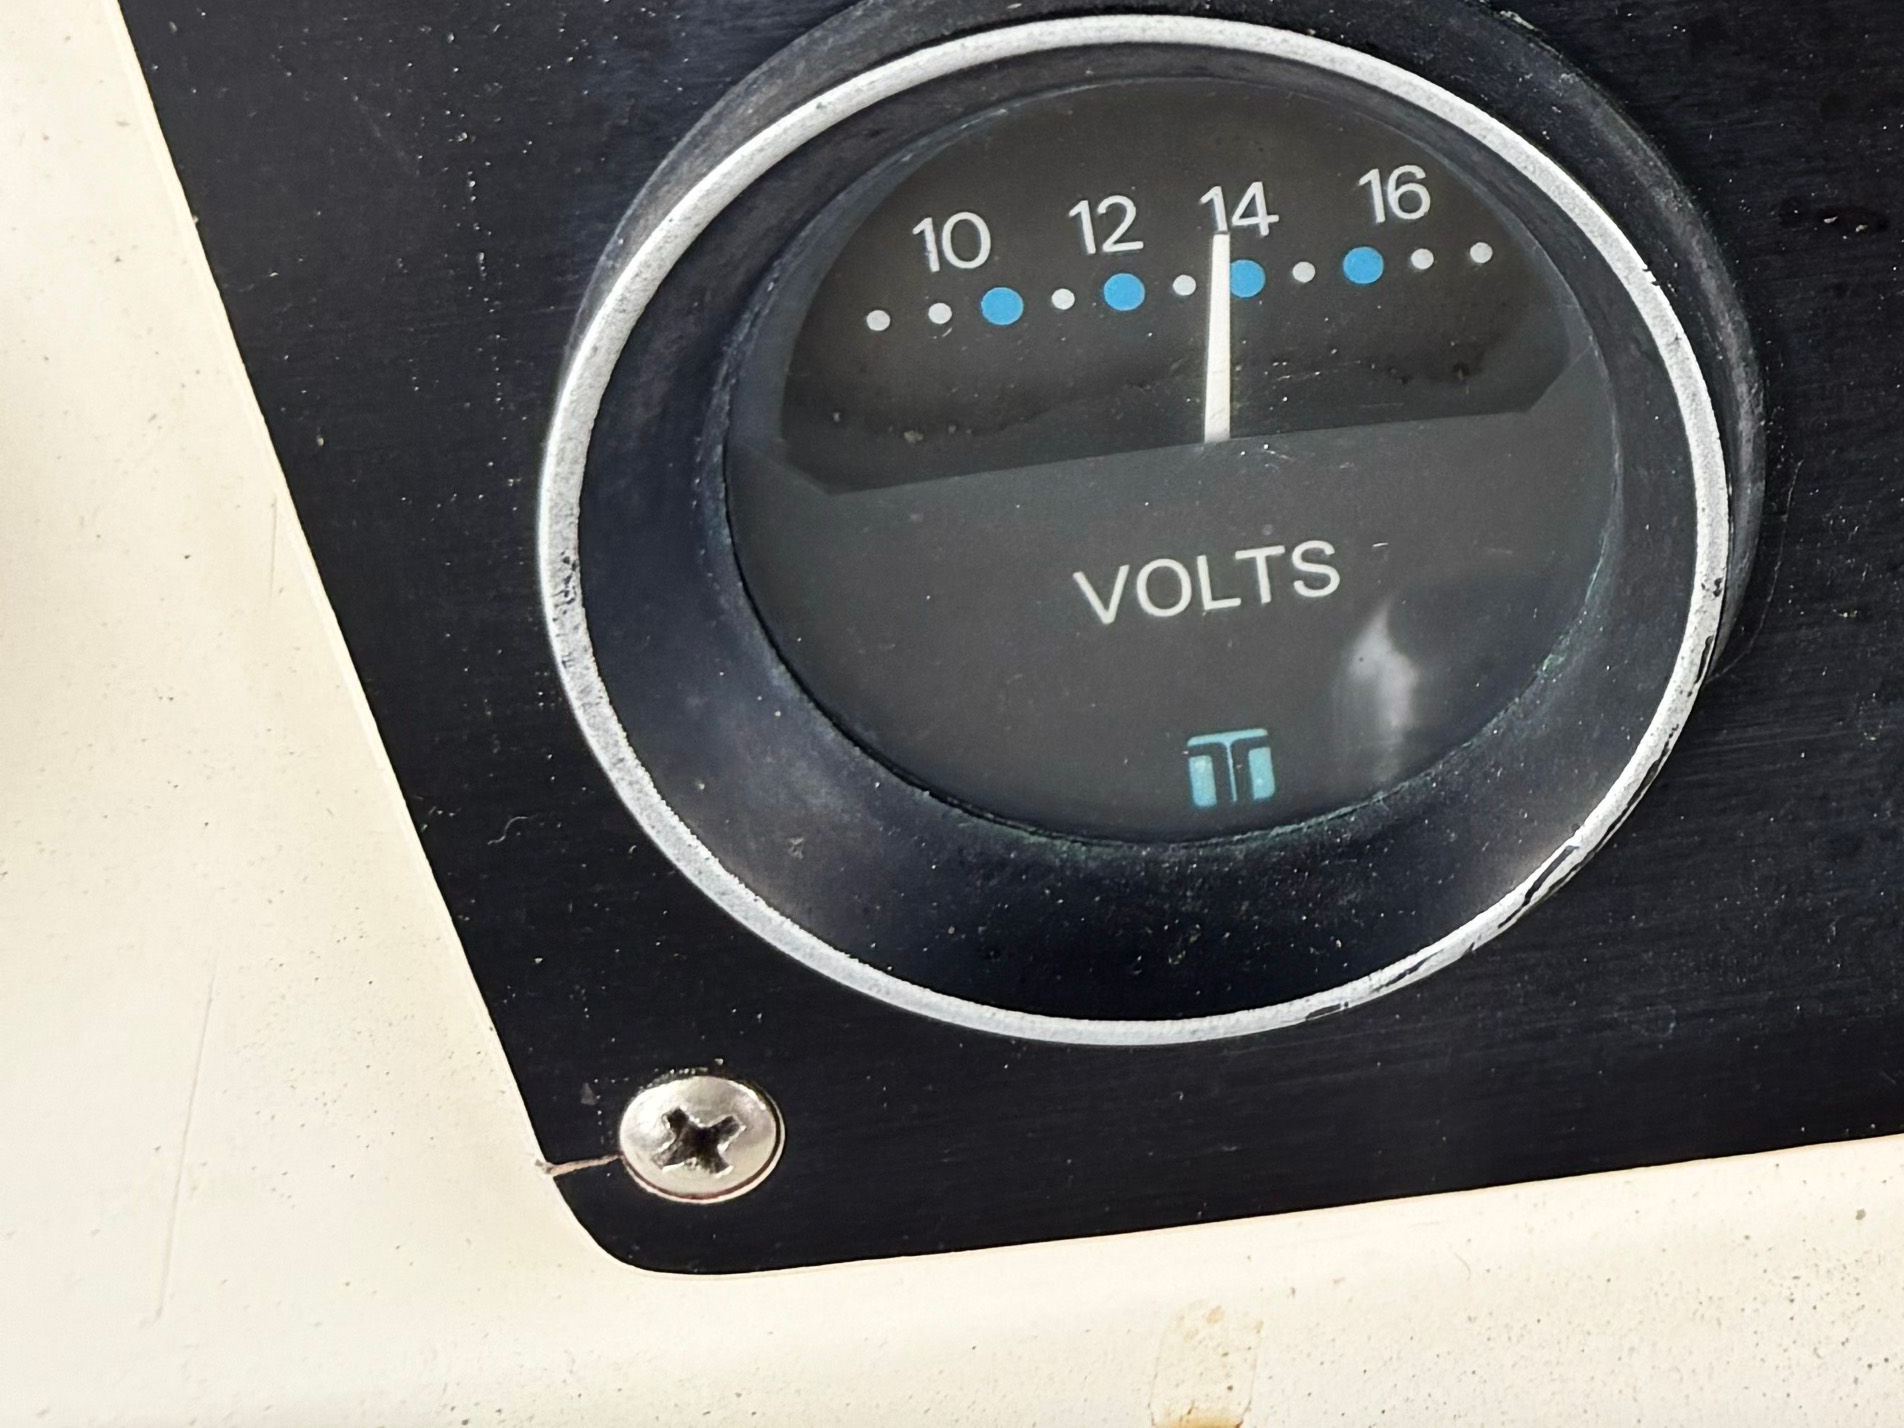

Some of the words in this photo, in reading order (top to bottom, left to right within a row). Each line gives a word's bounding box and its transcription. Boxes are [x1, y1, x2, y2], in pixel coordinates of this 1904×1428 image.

[913, 212, 990, 272] 10
[1069, 196, 1143, 254] 12
[1200, 181, 1280, 237] 14
[1359, 165, 1430, 223] 16
[1073, 541, 1340, 624] VOLTS
